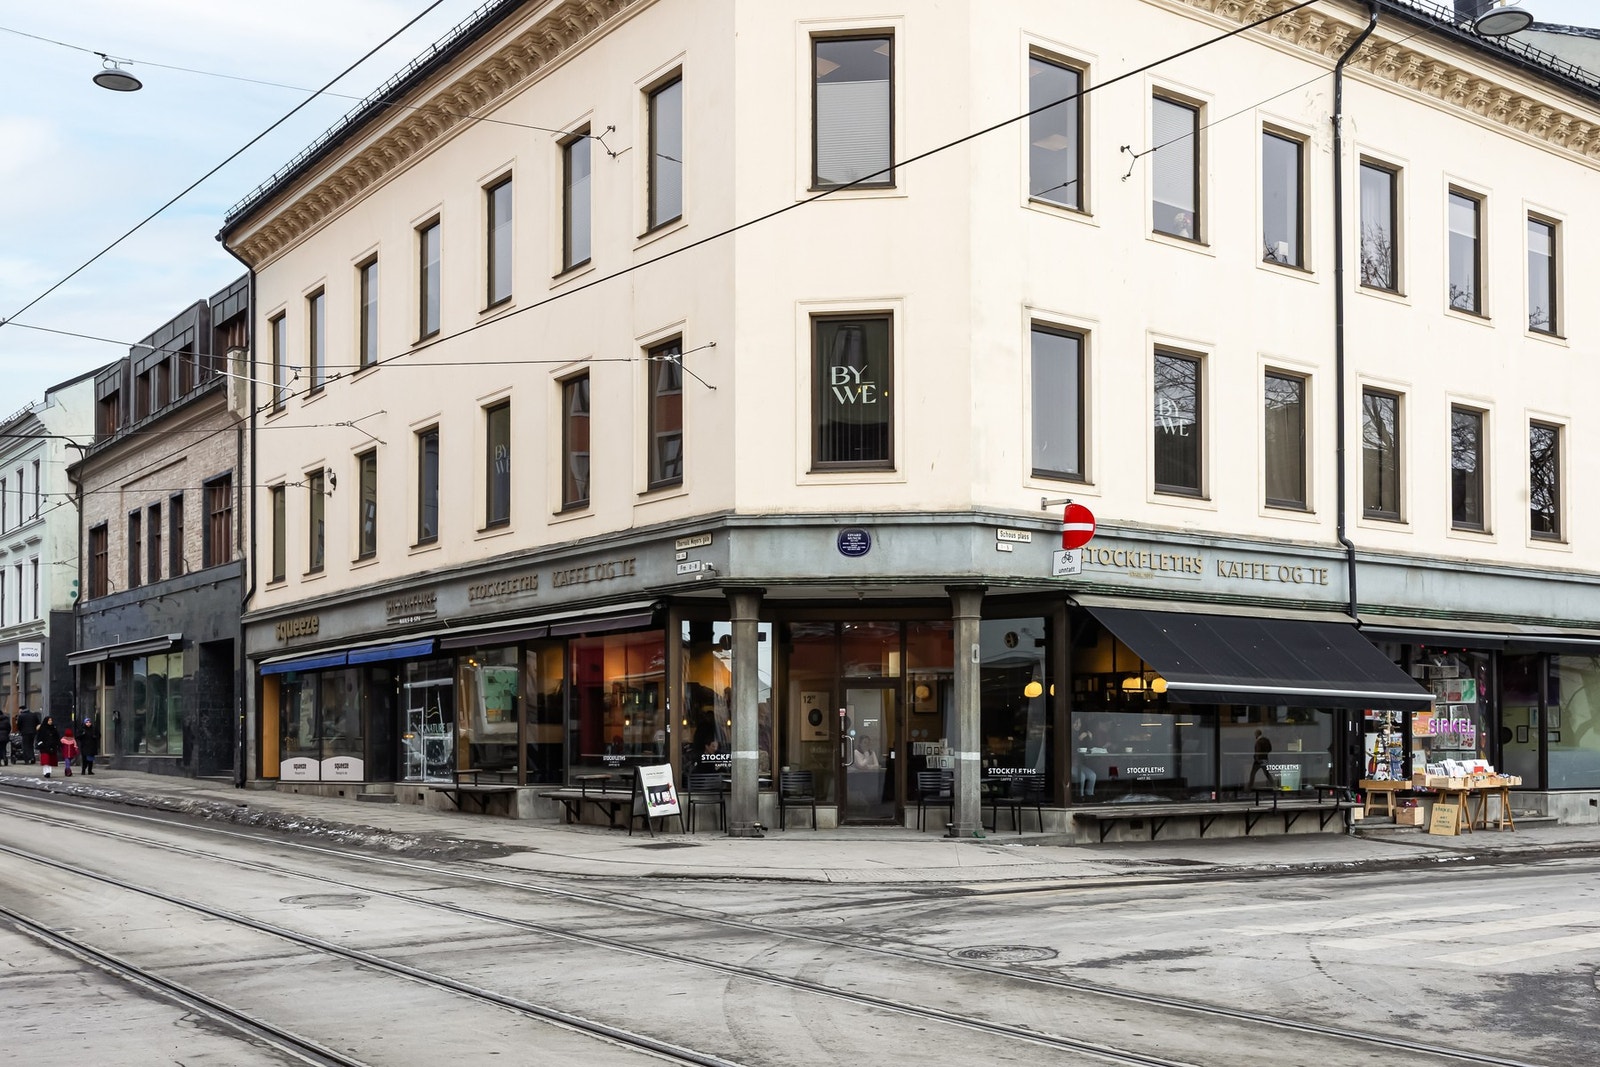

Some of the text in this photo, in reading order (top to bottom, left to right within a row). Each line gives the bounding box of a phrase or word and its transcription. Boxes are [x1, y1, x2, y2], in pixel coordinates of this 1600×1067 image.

[831, 364, 868, 385] BY
[831, 385, 877, 405] WE
[1160, 398, 1181, 417] BY
[1160, 416, 1189, 437] WE
[1000, 530, 1030, 540] Schous plass
[468, 557, 637, 601] STOCKFLETHS KAFFE OG TE
[1217, 559, 1270, 581] KAFFE
[1278, 564, 1303, 584] OG
[1310, 566, 1329, 586] TE
[275, 614, 319, 646] squeeze
[1428, 717, 1475, 735] SIRKEL
[1126, 766, 1165, 774] STOCKFLETHS
